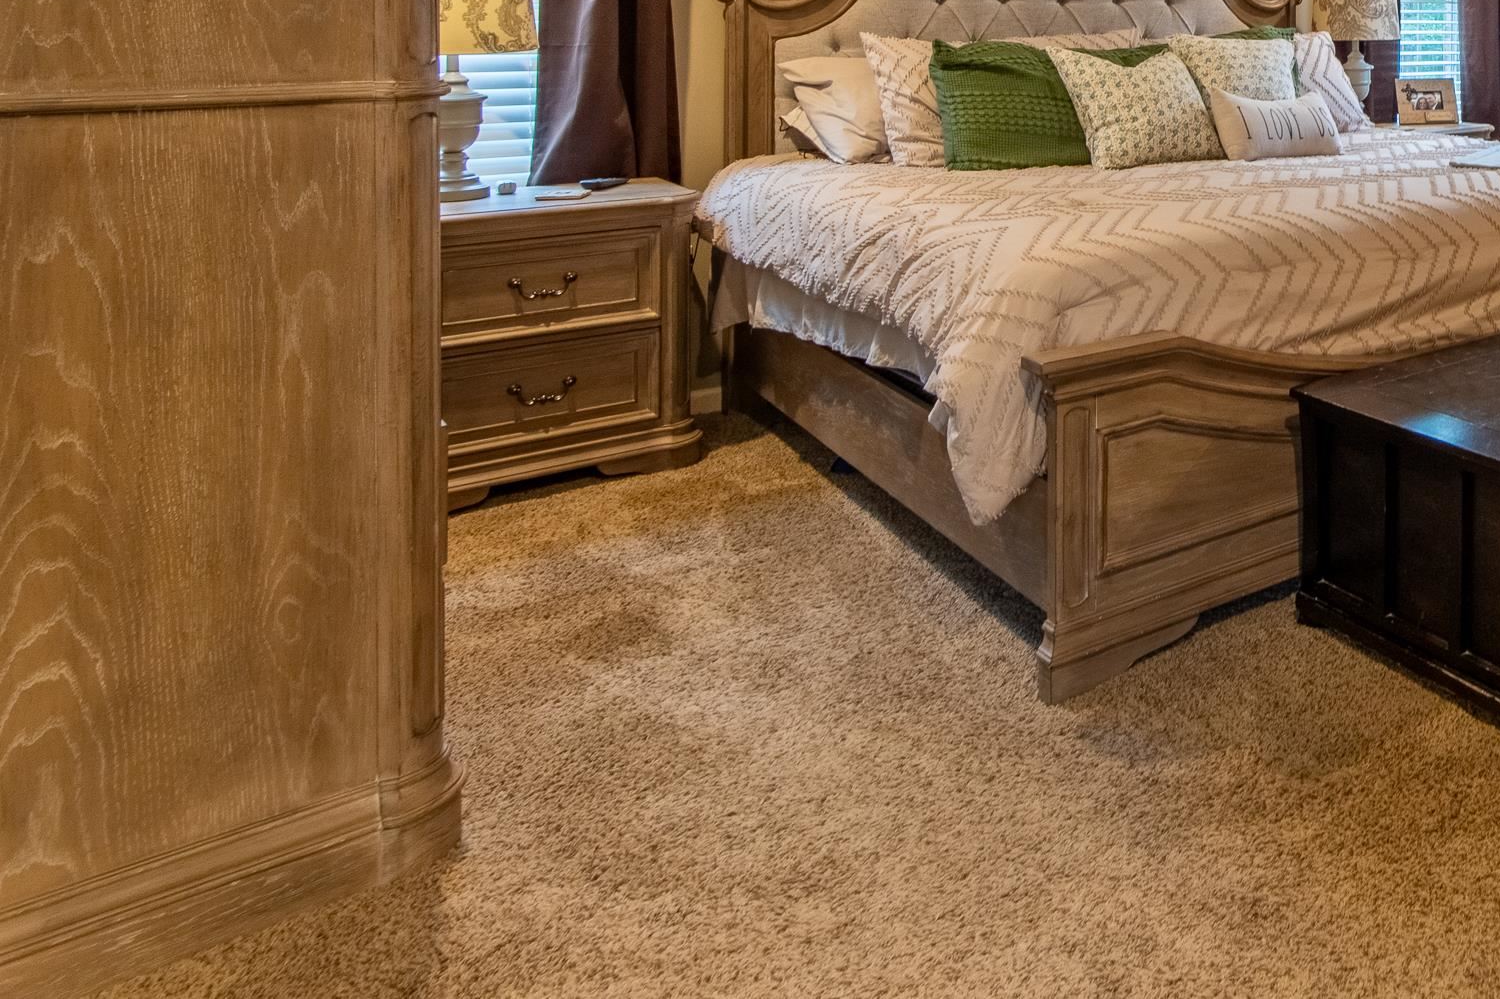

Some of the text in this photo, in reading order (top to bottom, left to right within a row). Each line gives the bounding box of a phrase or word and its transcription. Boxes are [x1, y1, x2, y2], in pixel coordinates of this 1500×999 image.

[1237, 105, 1335, 141] I LOVE US
